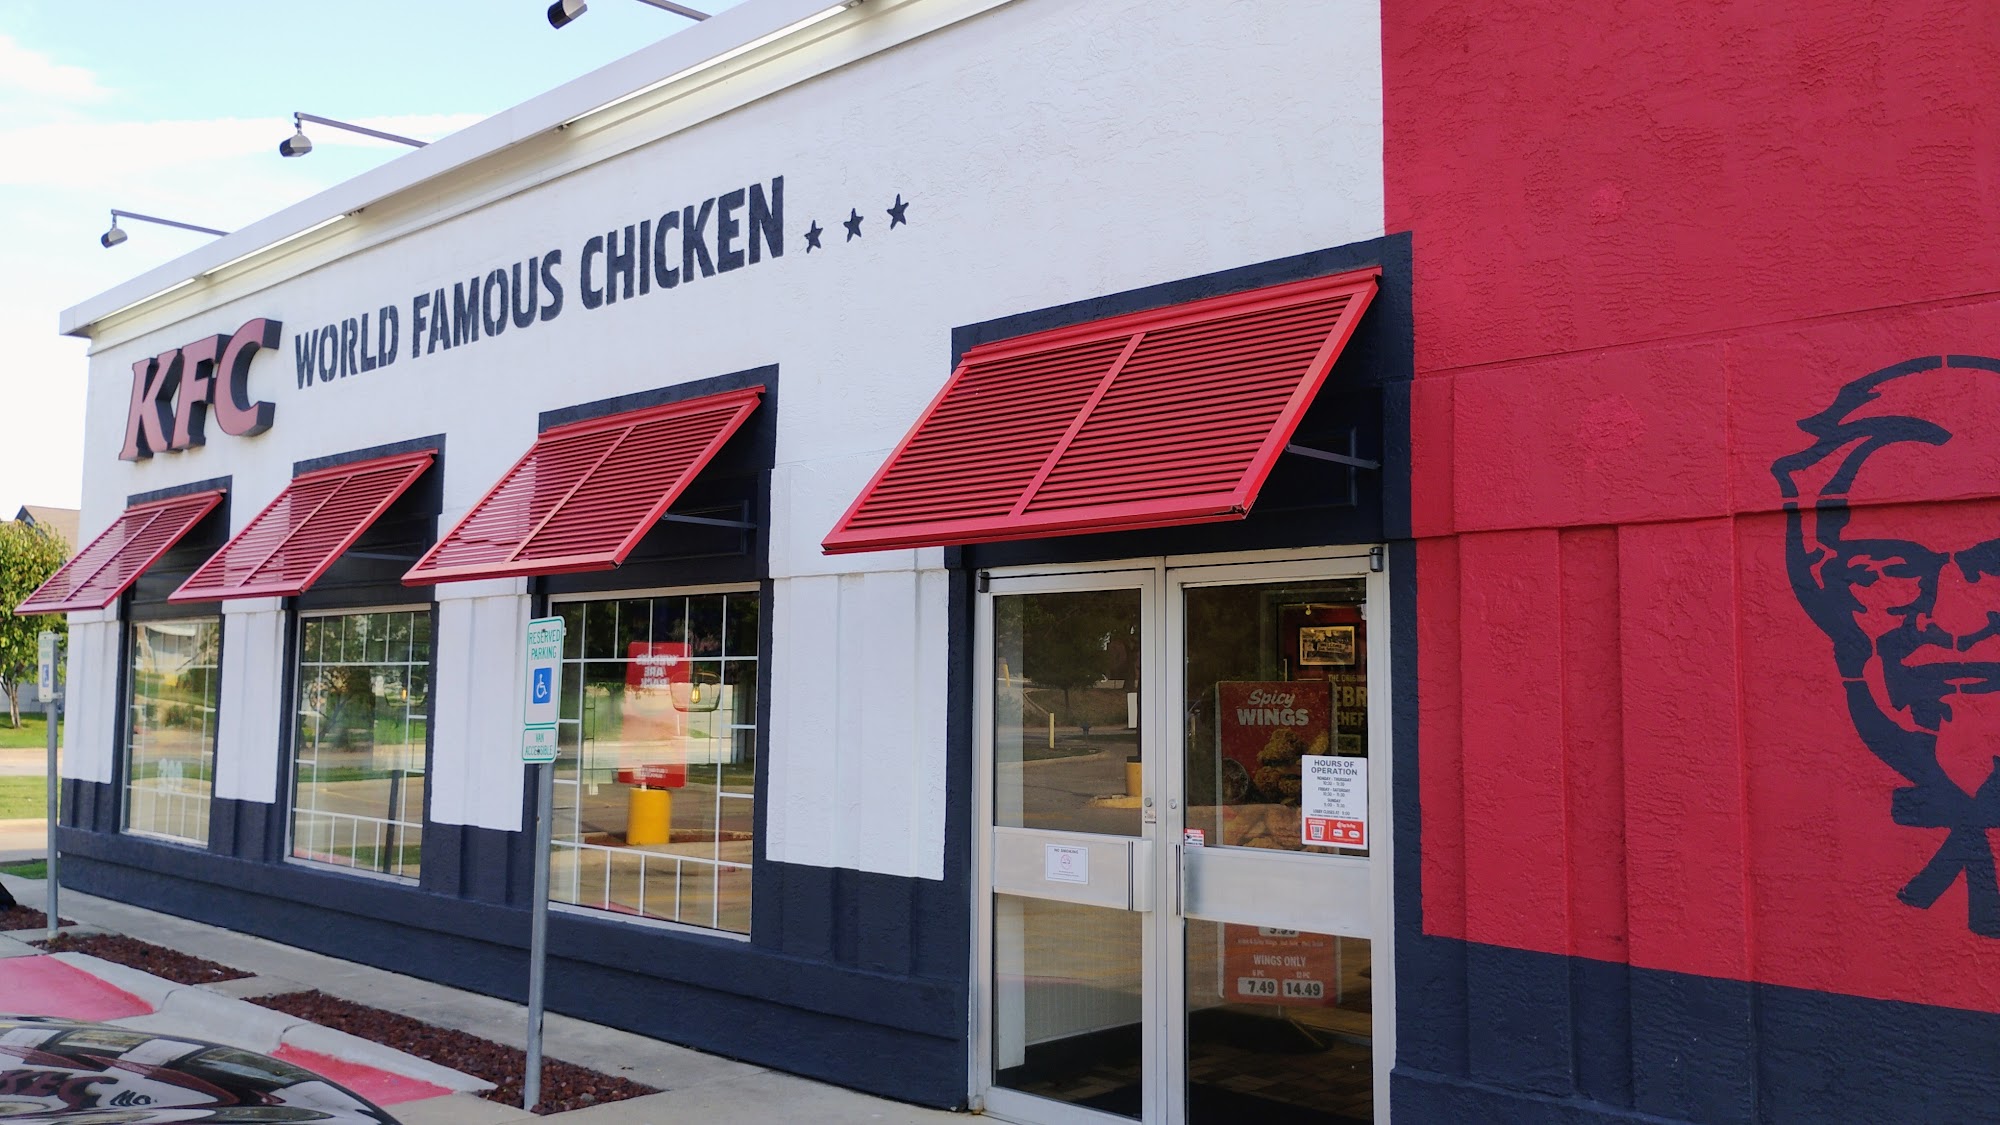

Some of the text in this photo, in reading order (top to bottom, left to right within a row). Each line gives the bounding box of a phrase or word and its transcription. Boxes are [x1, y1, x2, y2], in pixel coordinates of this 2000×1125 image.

[294, 174, 785, 390] WORLD FAMOUS CHICKEN
[118, 317, 283, 463] KFC
[528, 629, 561, 645] RESERVED
[531, 646, 558, 660] PARKING
[1248, 689, 1296, 708] Spicy
[1236, 708, 1309, 726] WINGS
[535, 733, 545, 742] VAN
[525, 745, 553, 756] ACCESSIBLE
[1310, 766, 1358, 775] OPERATION
[1253, 954, 1307, 967] WINGS ONLY
[1248, 980, 1321, 996] 7.49 14.49
